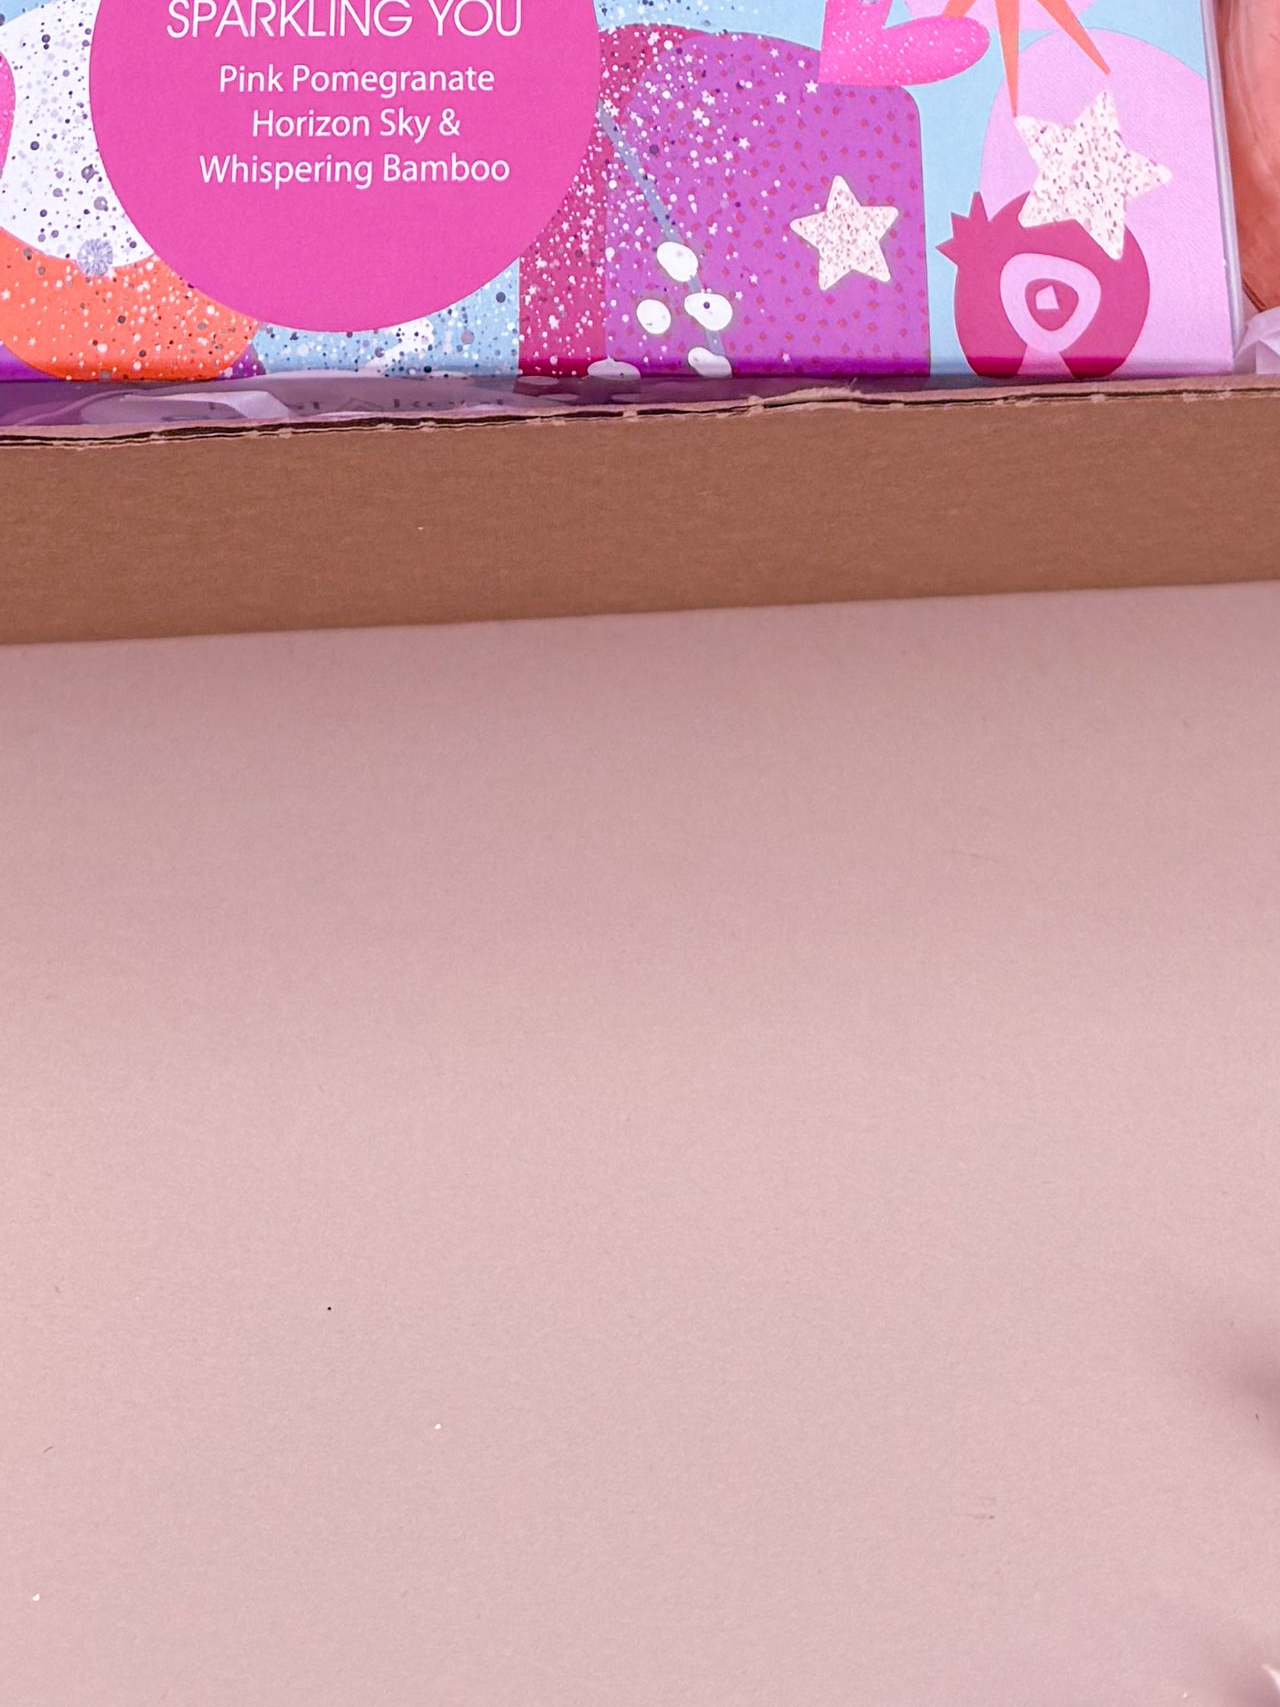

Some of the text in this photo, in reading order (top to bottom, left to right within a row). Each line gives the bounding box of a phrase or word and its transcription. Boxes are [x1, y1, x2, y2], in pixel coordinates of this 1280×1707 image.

[219, 63, 495, 98] Pink Pomegranate
[252, 108, 460, 143] Horizon Sky &
[199, 153, 510, 189] Whispering Bamboo
